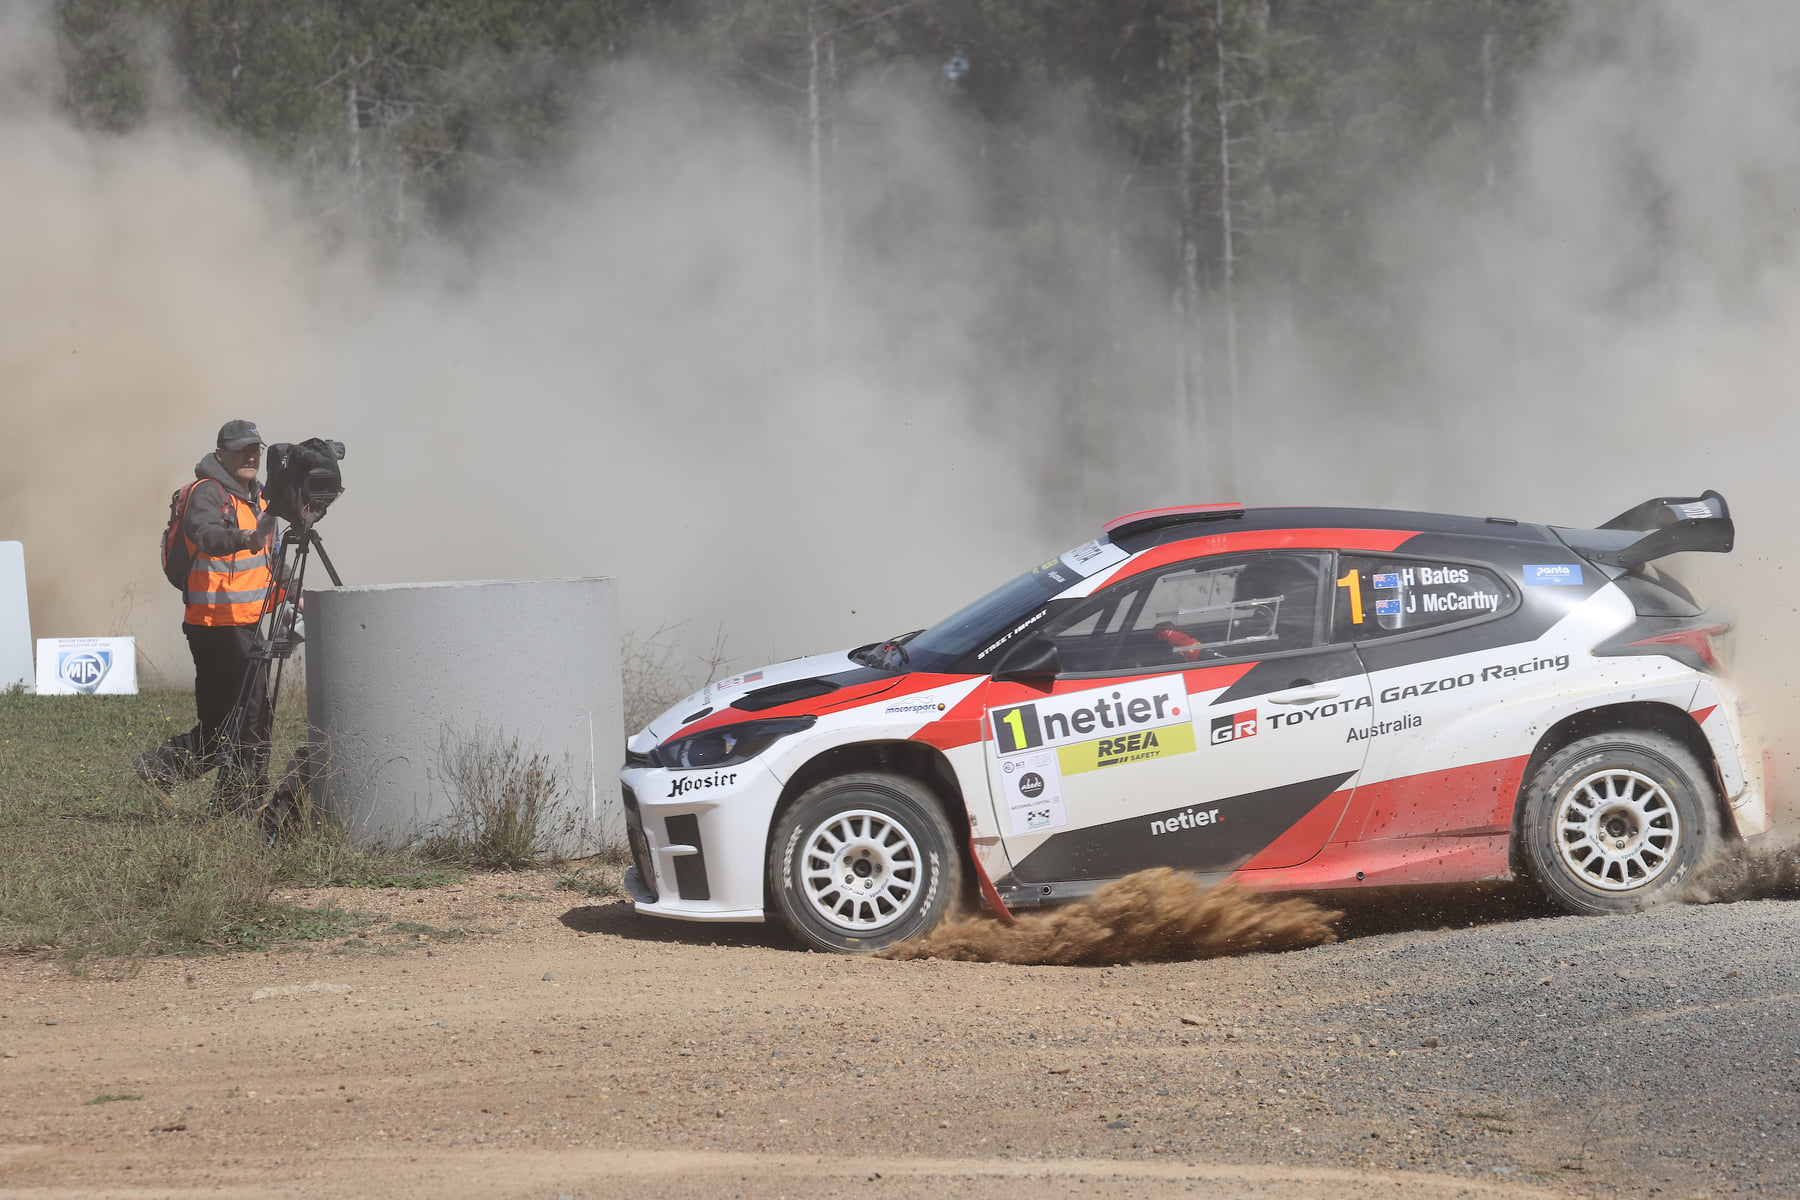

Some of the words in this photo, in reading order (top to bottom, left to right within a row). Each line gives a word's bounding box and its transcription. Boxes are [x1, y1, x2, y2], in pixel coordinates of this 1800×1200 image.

[1402, 568, 1415, 586] H
[1421, 567, 1469, 586] Bates
[1337, 569, 1363, 624] 1
[1406, 591, 1417, 613] J
[1423, 591, 1499, 613] McCarthy
[977, 632, 1013, 660] STREET
[1014, 609, 1048, 634] IMPACT
[67, 658, 101, 683] MTA
[1266, 695, 1372, 730] TOYOTA
[1380, 673, 1475, 704] GAZOO
[1482, 654, 1570, 682] Racing
[885, 703, 936, 714] motorsport
[1044, 691, 1180, 741] netier.
[1003, 708, 1028, 750] 1
[1211, 720, 1257, 745] GR
[1346, 713, 1423, 744] Australia
[1098, 731, 1159, 758] RSEA
[1130, 750, 1161, 762] SAFETY
[666, 771, 737, 798] Hoosier
[1150, 808, 1225, 836] netier.
